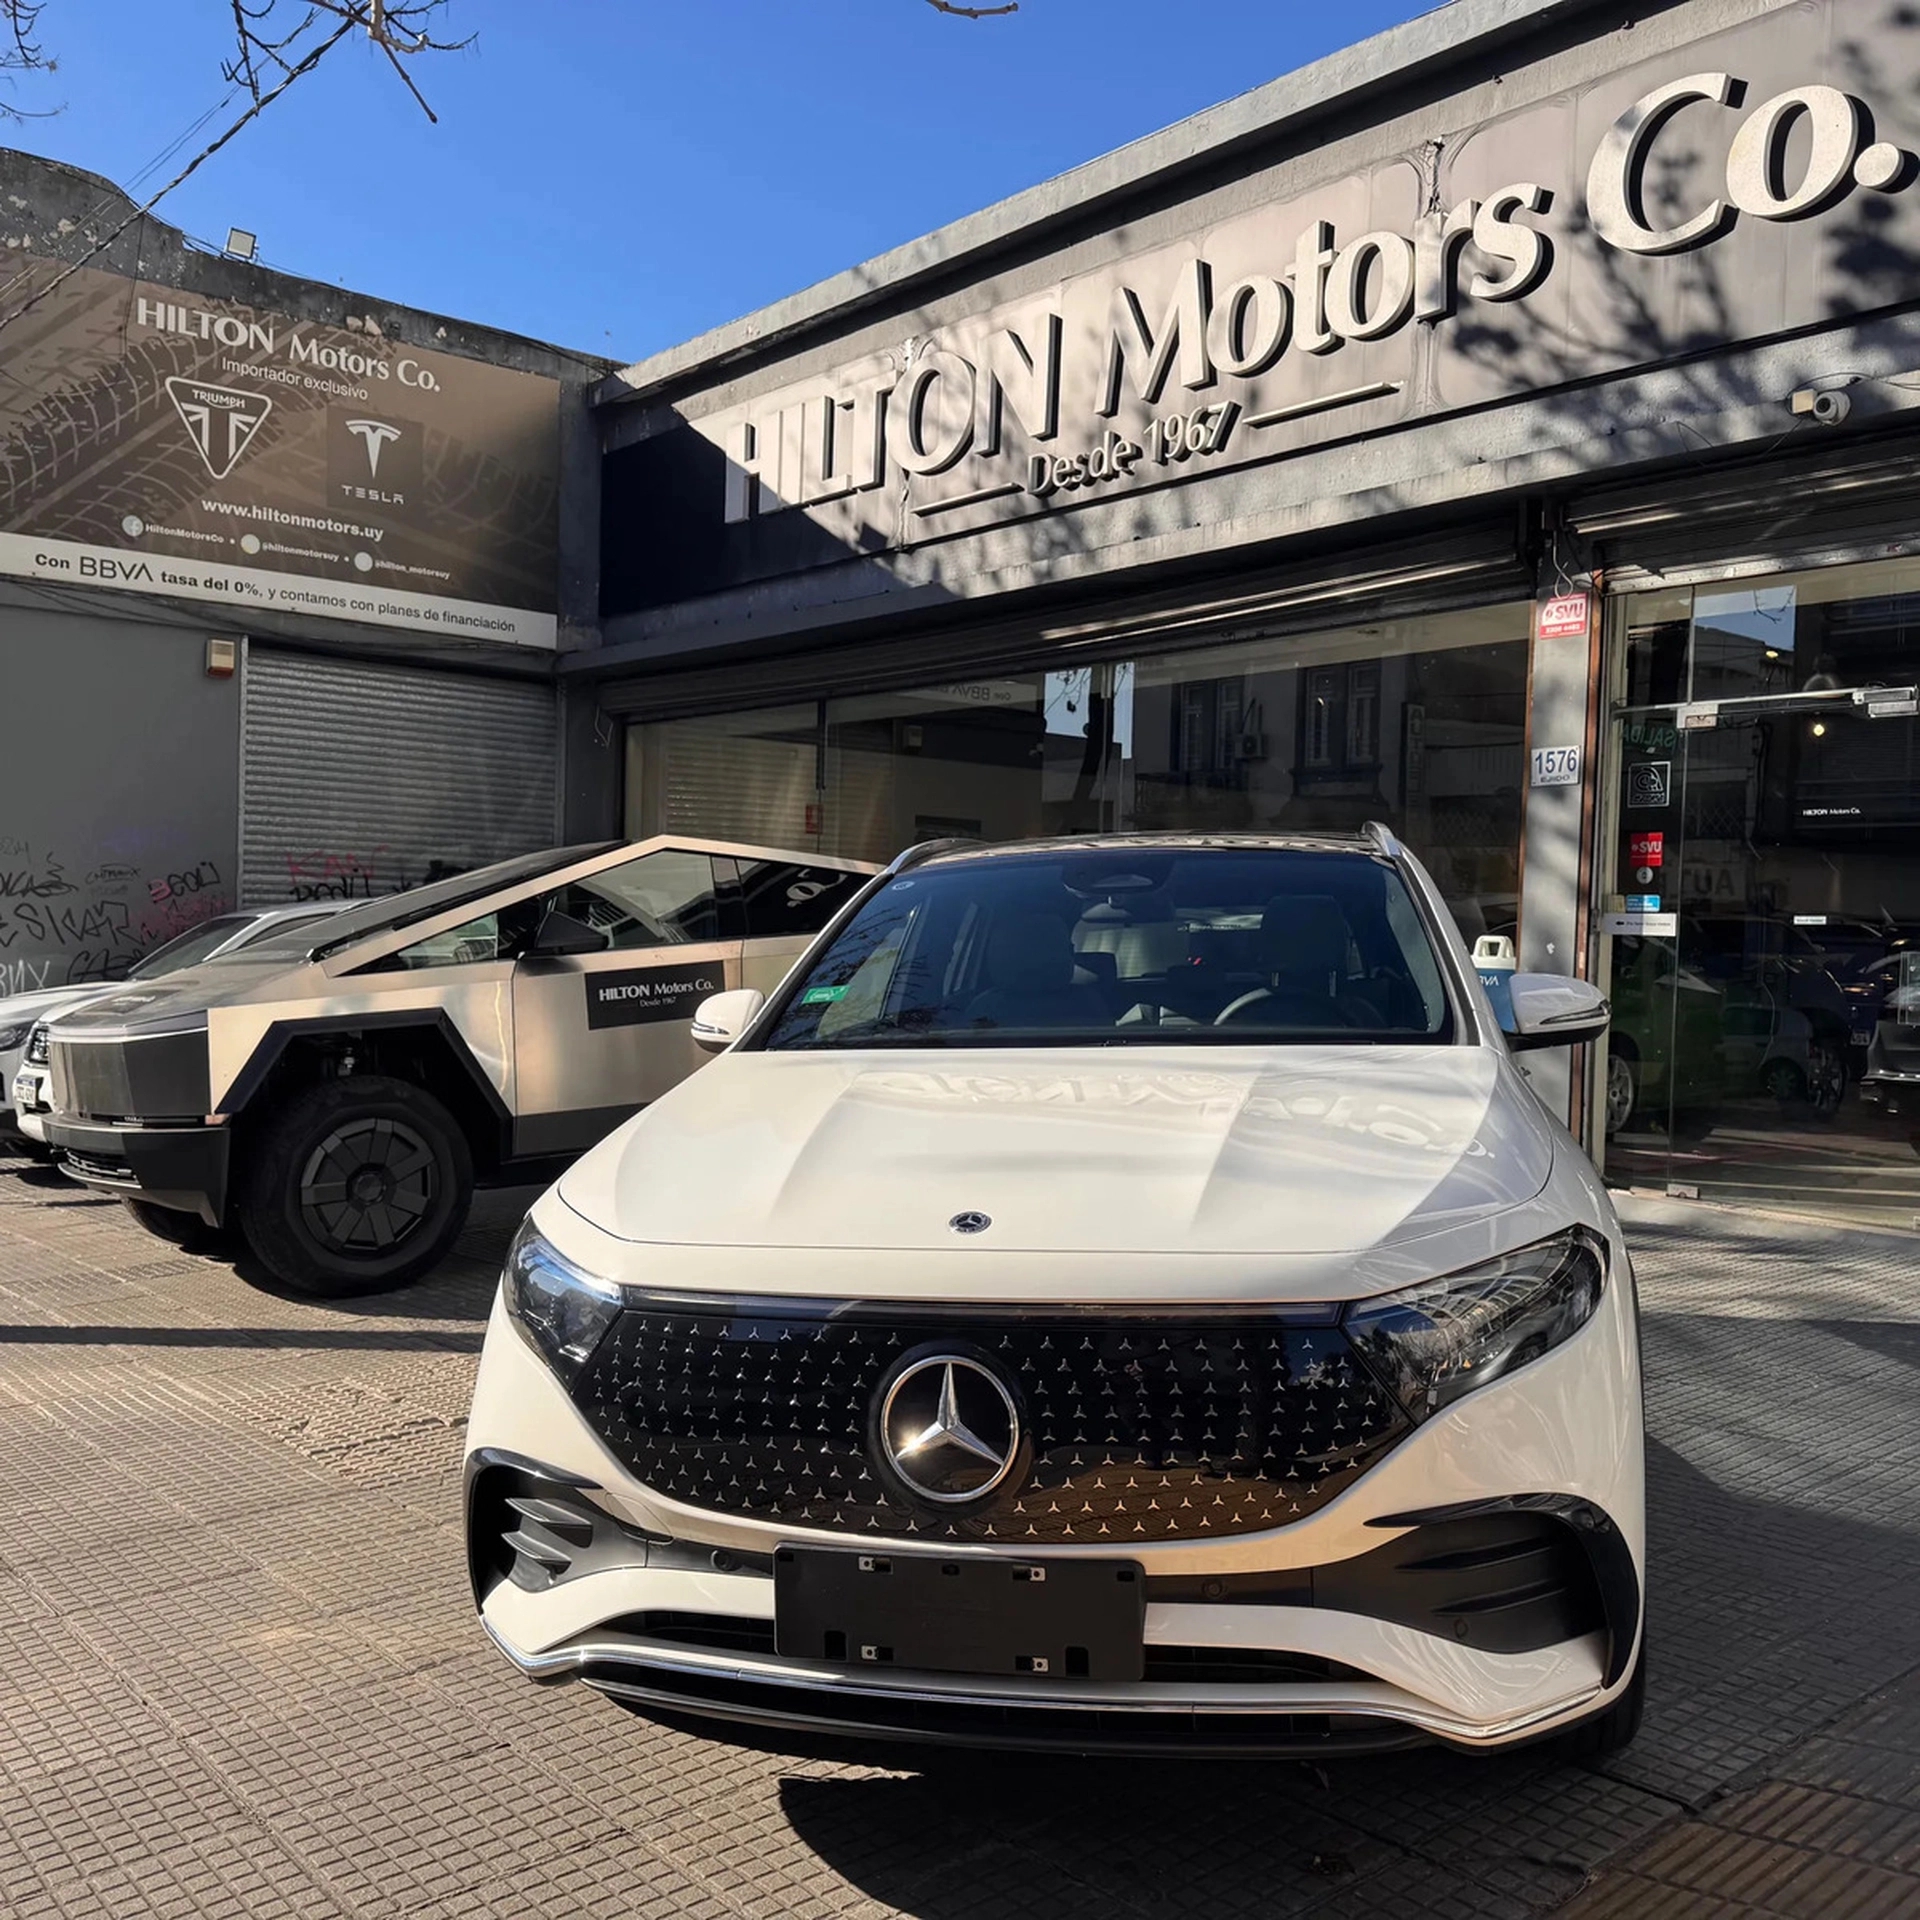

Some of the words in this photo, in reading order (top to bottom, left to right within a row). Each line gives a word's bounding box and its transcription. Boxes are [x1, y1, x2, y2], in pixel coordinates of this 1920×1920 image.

[725, 313, 1063, 524] HILTON
[1094, 183, 1555, 418] Motors
[1586, 72, 1918, 256] Co.
[137, 297, 274, 354] HILTON
[289, 334, 390, 381] Motors
[397, 359, 441, 393] Co.
[222, 357, 301, 387] Importador
[304, 375, 368, 400] exclusivo
[192, 388, 246, 409] TRIUMPH
[1027, 430, 1139, 497] Desde
[1143, 400, 1242, 466] 1967
[341, 484, 404, 505] TESLA
[145, 523, 225, 544] HiltonMotorsCo
[202, 499, 384, 542] www.hiltonmotors.uy
[35, 553, 70, 570] Con
[79, 556, 154, 582] BBVA
[161, 570, 198, 588] tasa
[203, 576, 229, 591] del
[234, 580, 263, 598] 0%,
[268, 586, 276, 601] y
[280, 589, 347, 608] contamos
[350, 597, 374, 612] con
[378, 601, 420, 619] planes
[424, 606, 439, 622] de
[442, 610, 516, 633] financiación
[1555, 602, 1583, 620] SVU
[1535, 749, 1577, 775] 1576
[1640, 840, 1662, 854] SVU
[599, 985, 650, 1002] HILTON
[654, 981, 693, 996] Motors
[695, 978, 714, 992] Co.
